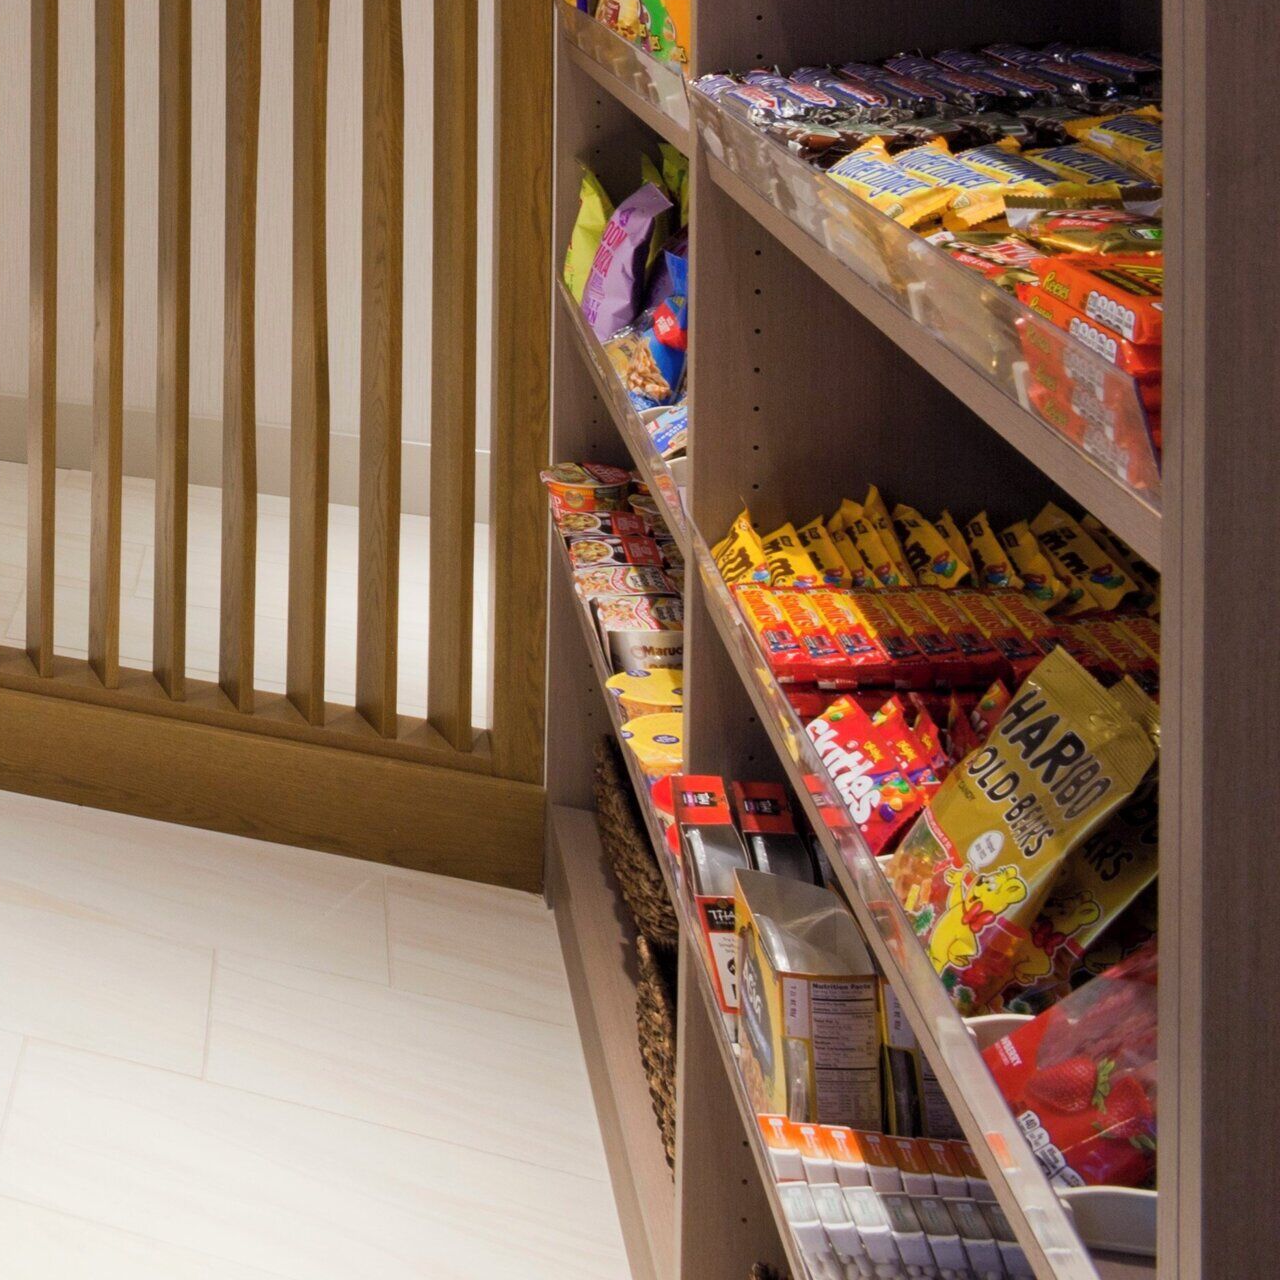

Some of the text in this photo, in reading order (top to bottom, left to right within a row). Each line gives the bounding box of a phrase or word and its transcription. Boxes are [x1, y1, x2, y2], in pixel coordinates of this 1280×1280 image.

[827, 151, 932, 199] Butterfinger
[1000, 689, 1112, 820] HARIBO
[966, 745, 1056, 859] OLD-BEARS
[813, 982, 872, 992] Nutrition Facts
[1022, 1113, 1038, 1130] 140
